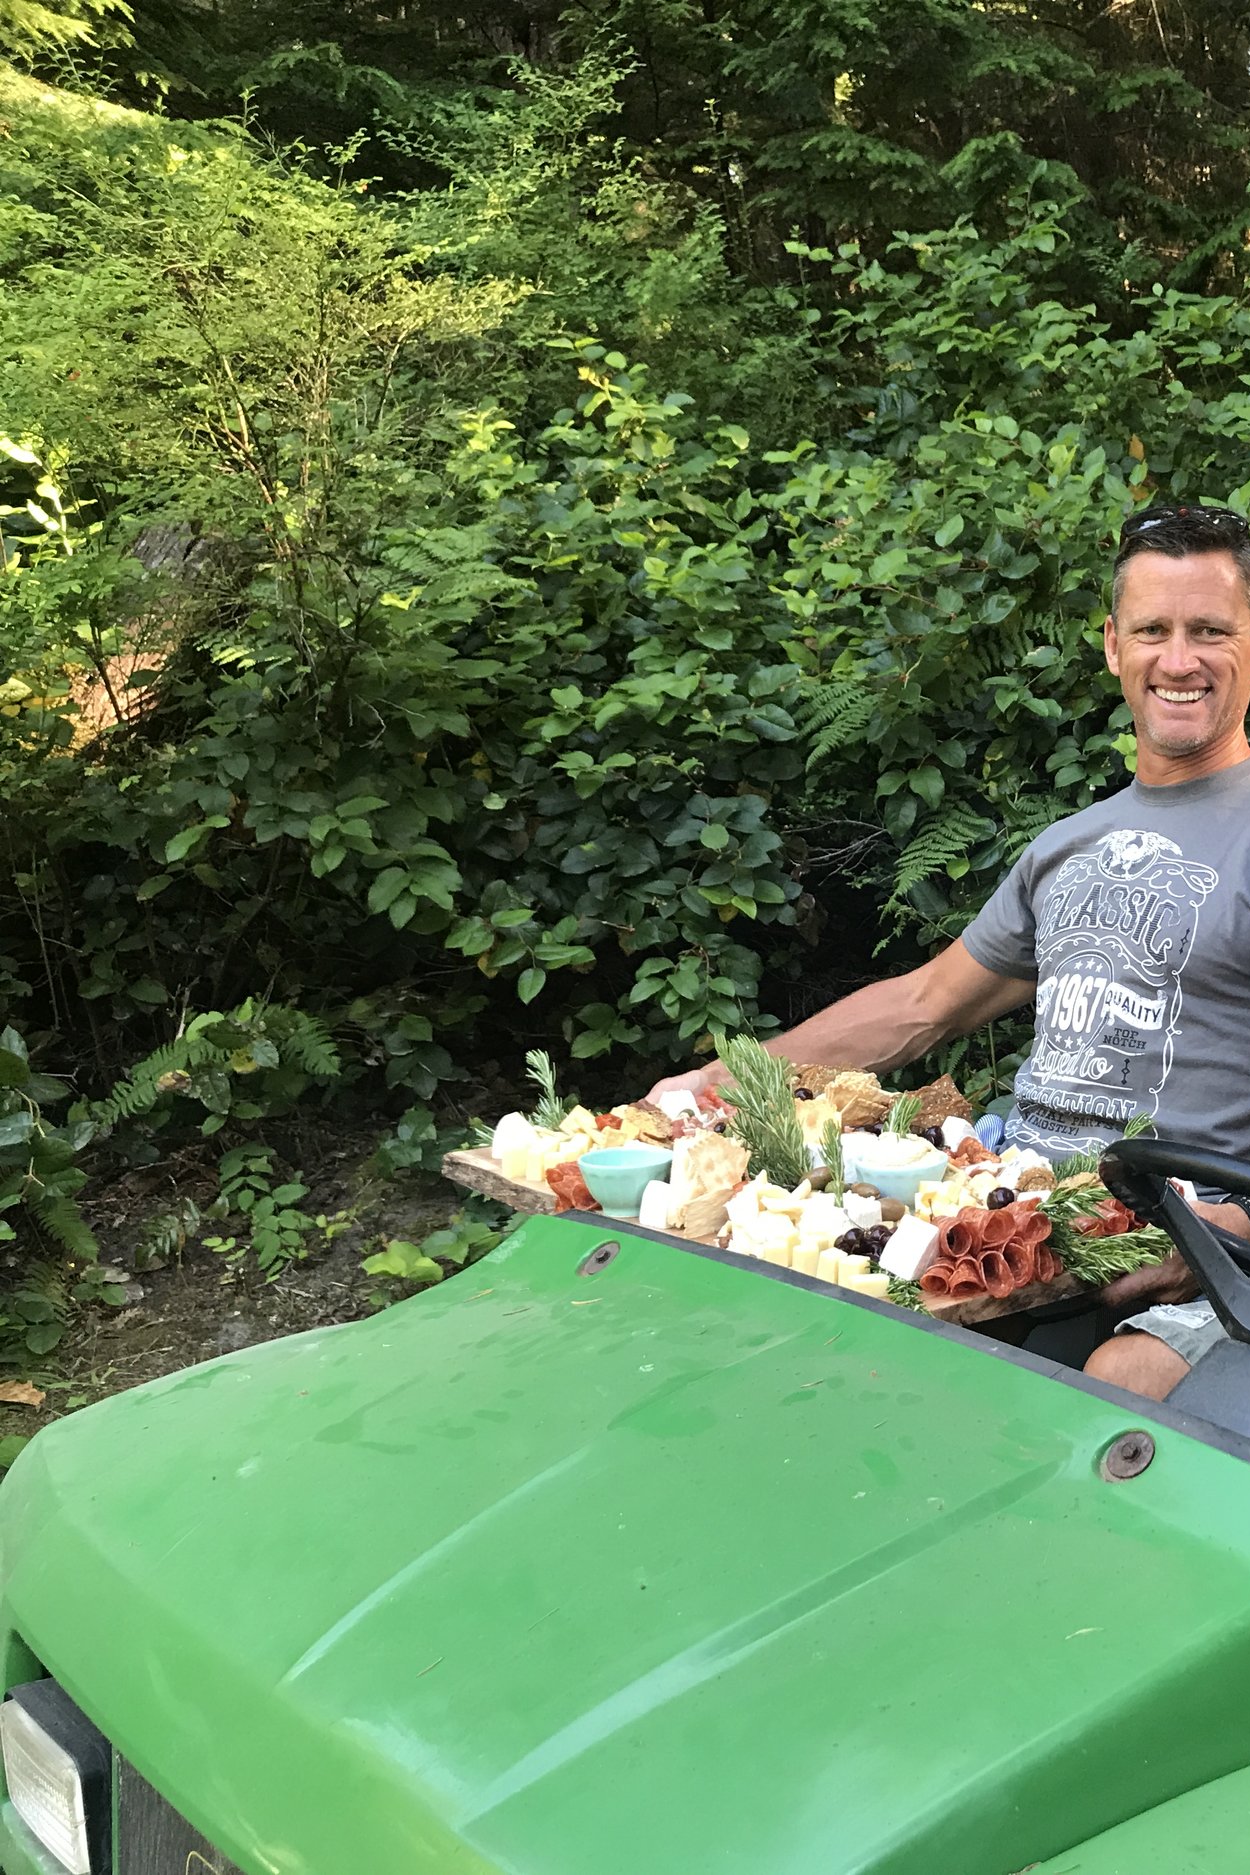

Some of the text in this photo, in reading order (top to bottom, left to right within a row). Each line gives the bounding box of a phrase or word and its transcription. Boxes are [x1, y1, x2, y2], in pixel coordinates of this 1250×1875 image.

[1036, 882, 1181, 965] CLASSIC
[1050, 972, 1108, 1034] 1967
[1105, 989, 1162, 1024] QUALITY
[1102, 1034, 1147, 1050] NOTCH
[1113, 1027, 1140, 1039] TOP
